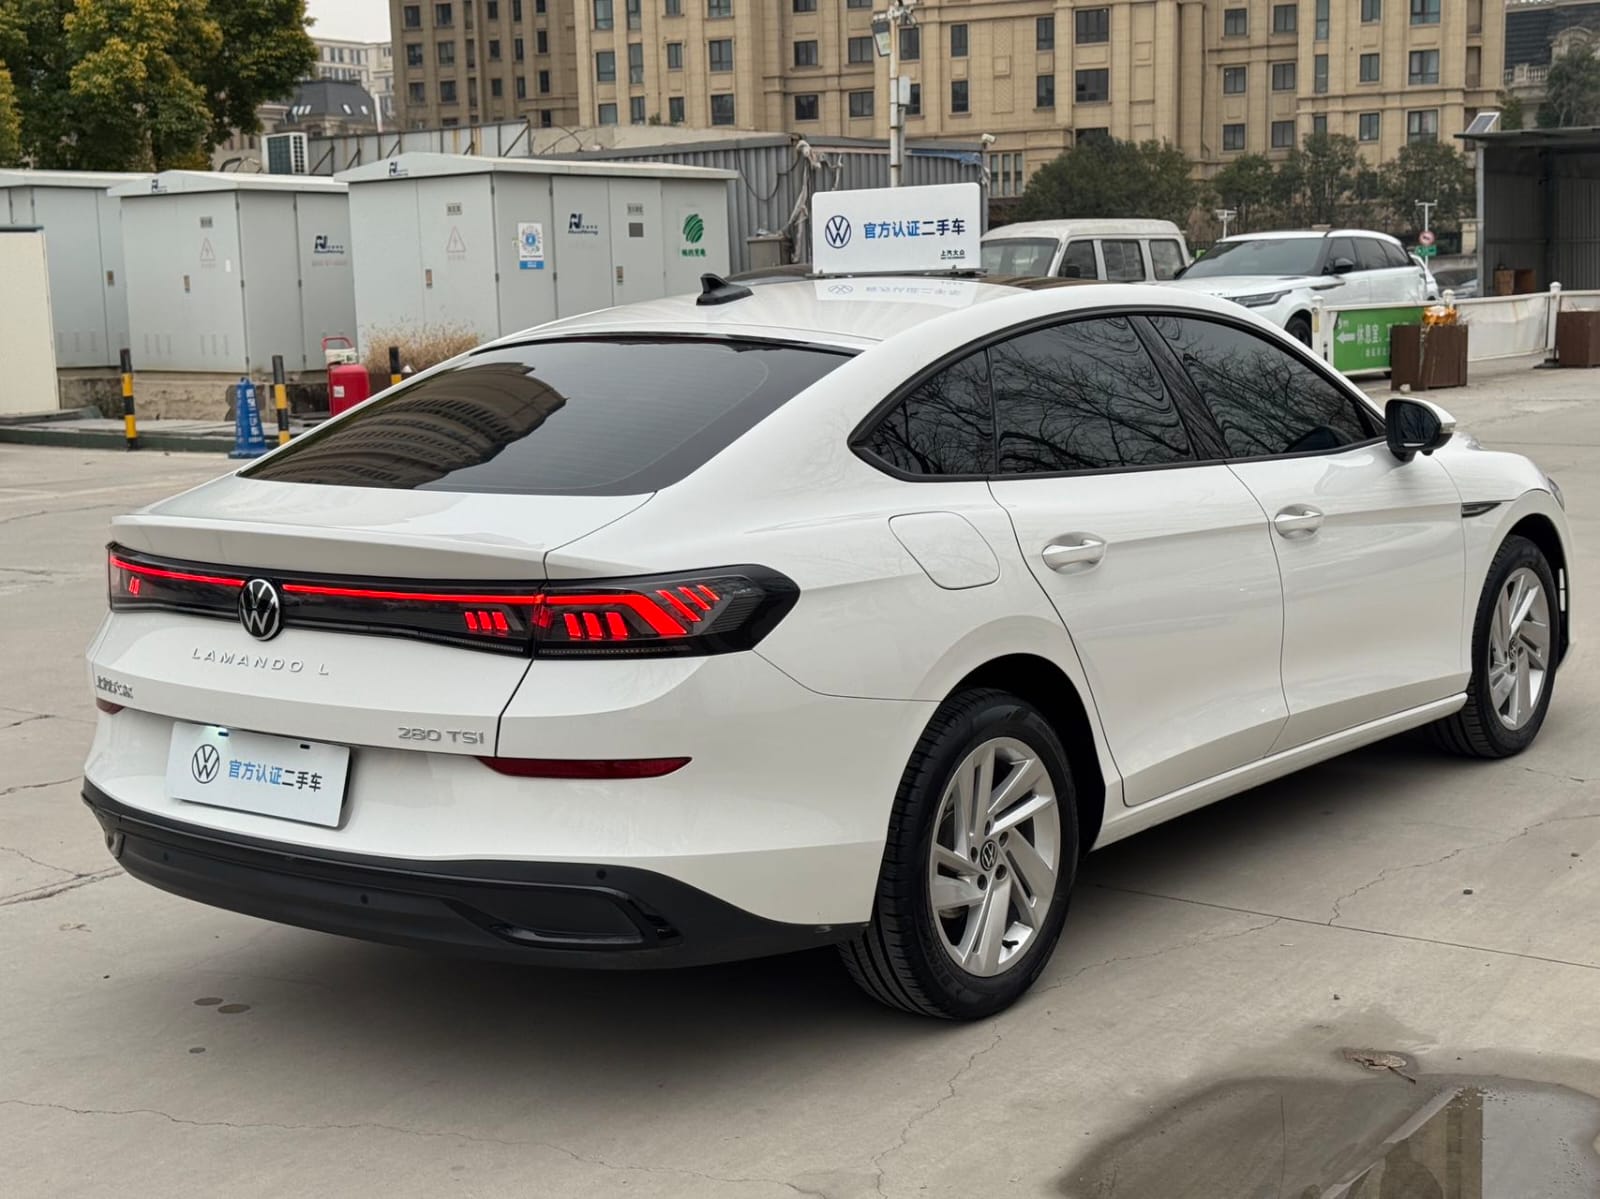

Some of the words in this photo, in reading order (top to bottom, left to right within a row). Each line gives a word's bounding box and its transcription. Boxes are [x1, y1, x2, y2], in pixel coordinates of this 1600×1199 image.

[863, 218, 966, 239] 官方认证二手车
[191, 648, 304, 673] LAMANDO
[318, 663, 330, 676] L
[397, 727, 443, 742] 280
[445, 729, 485, 744] TSI
[228, 759, 323, 793] 官方认证二手车
